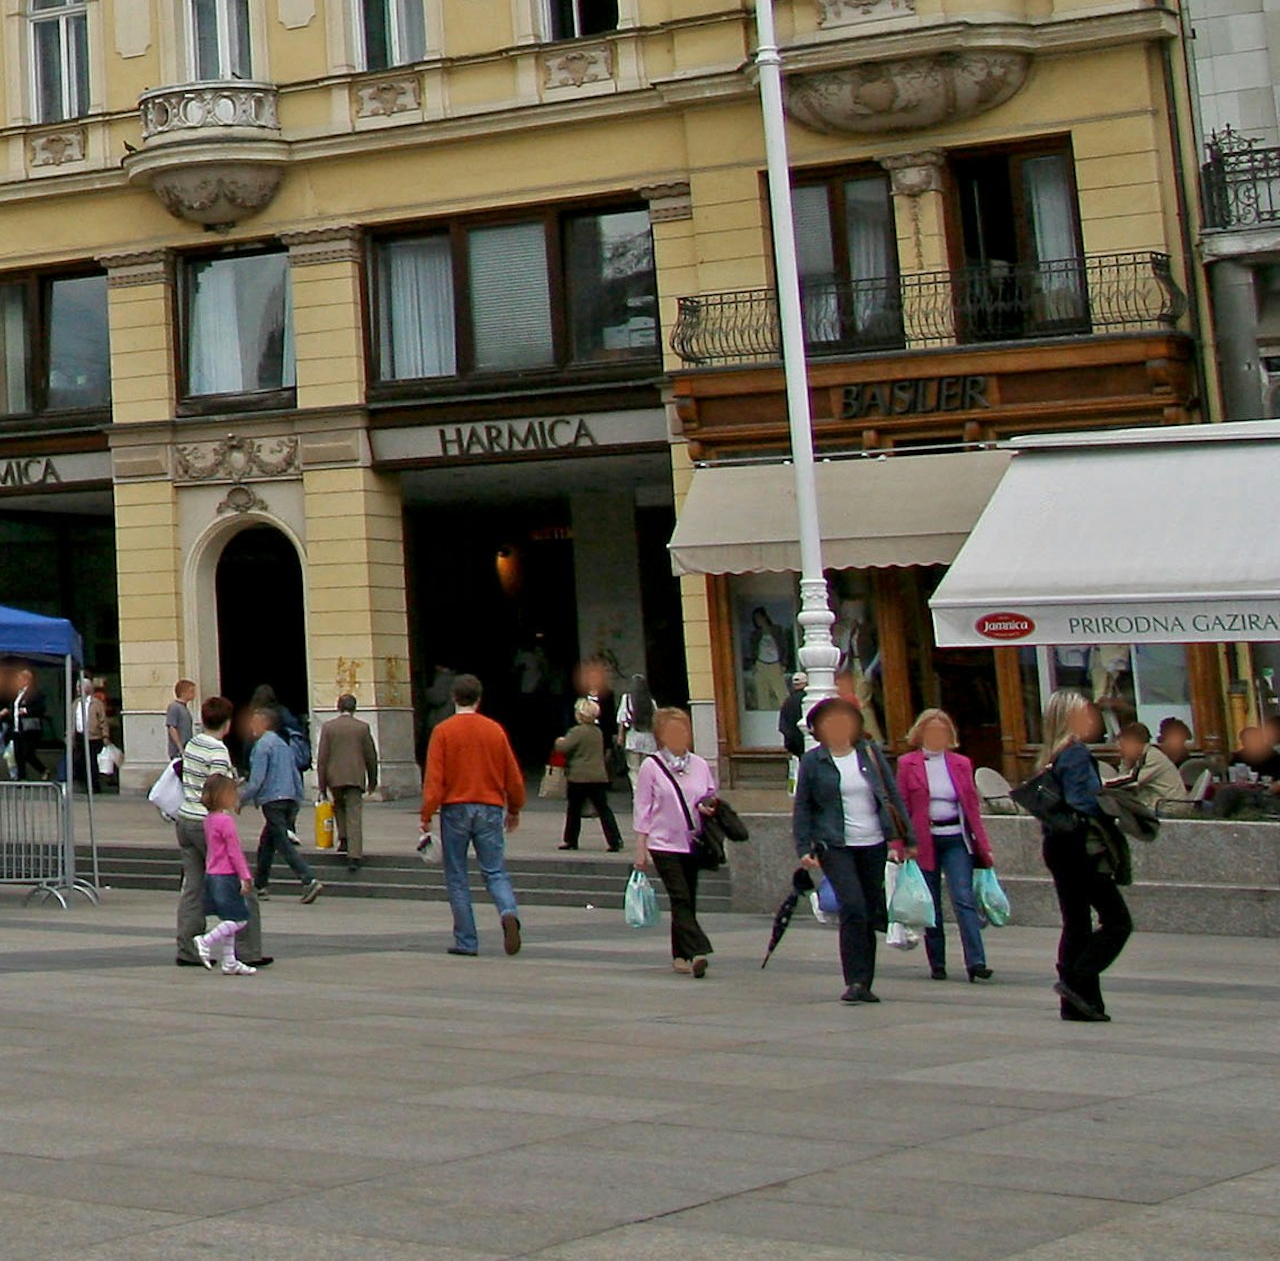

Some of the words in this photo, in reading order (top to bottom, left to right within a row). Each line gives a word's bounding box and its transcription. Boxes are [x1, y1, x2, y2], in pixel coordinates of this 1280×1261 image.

[841, 375, 990, 418] BASLER
[438, 418, 598, 456] HARMICA
[983, 620, 1028, 633] Jamnica
[1069, 614, 1186, 634] PRIRODNA
[1192, 613, 1279, 632] GAZIRA
